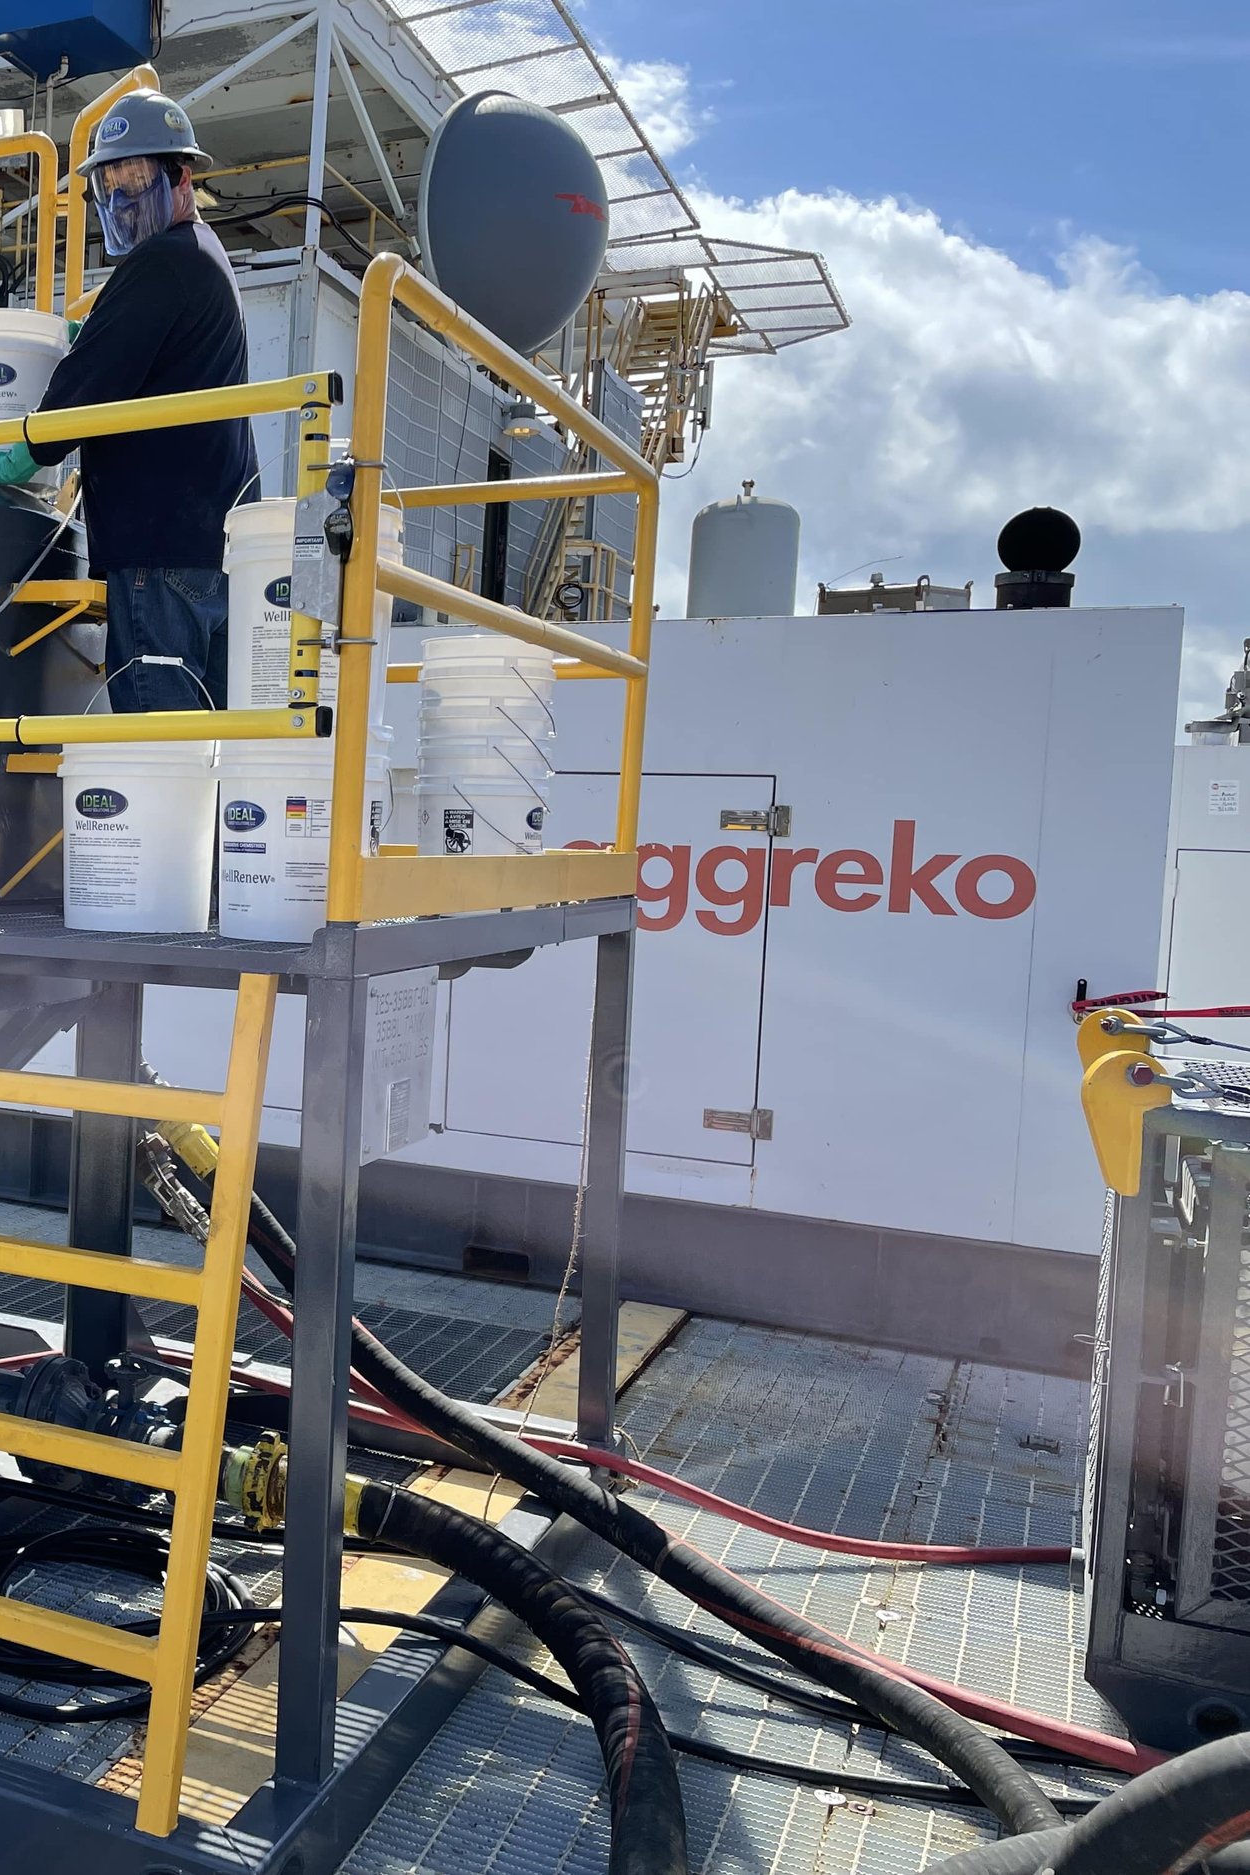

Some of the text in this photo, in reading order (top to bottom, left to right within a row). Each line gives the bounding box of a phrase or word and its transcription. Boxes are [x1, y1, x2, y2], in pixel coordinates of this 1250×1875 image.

[82, 795, 117, 807] IDEAL
[227, 808, 256, 821] IDEAL
[561, 819, 1038, 937] ggreko
